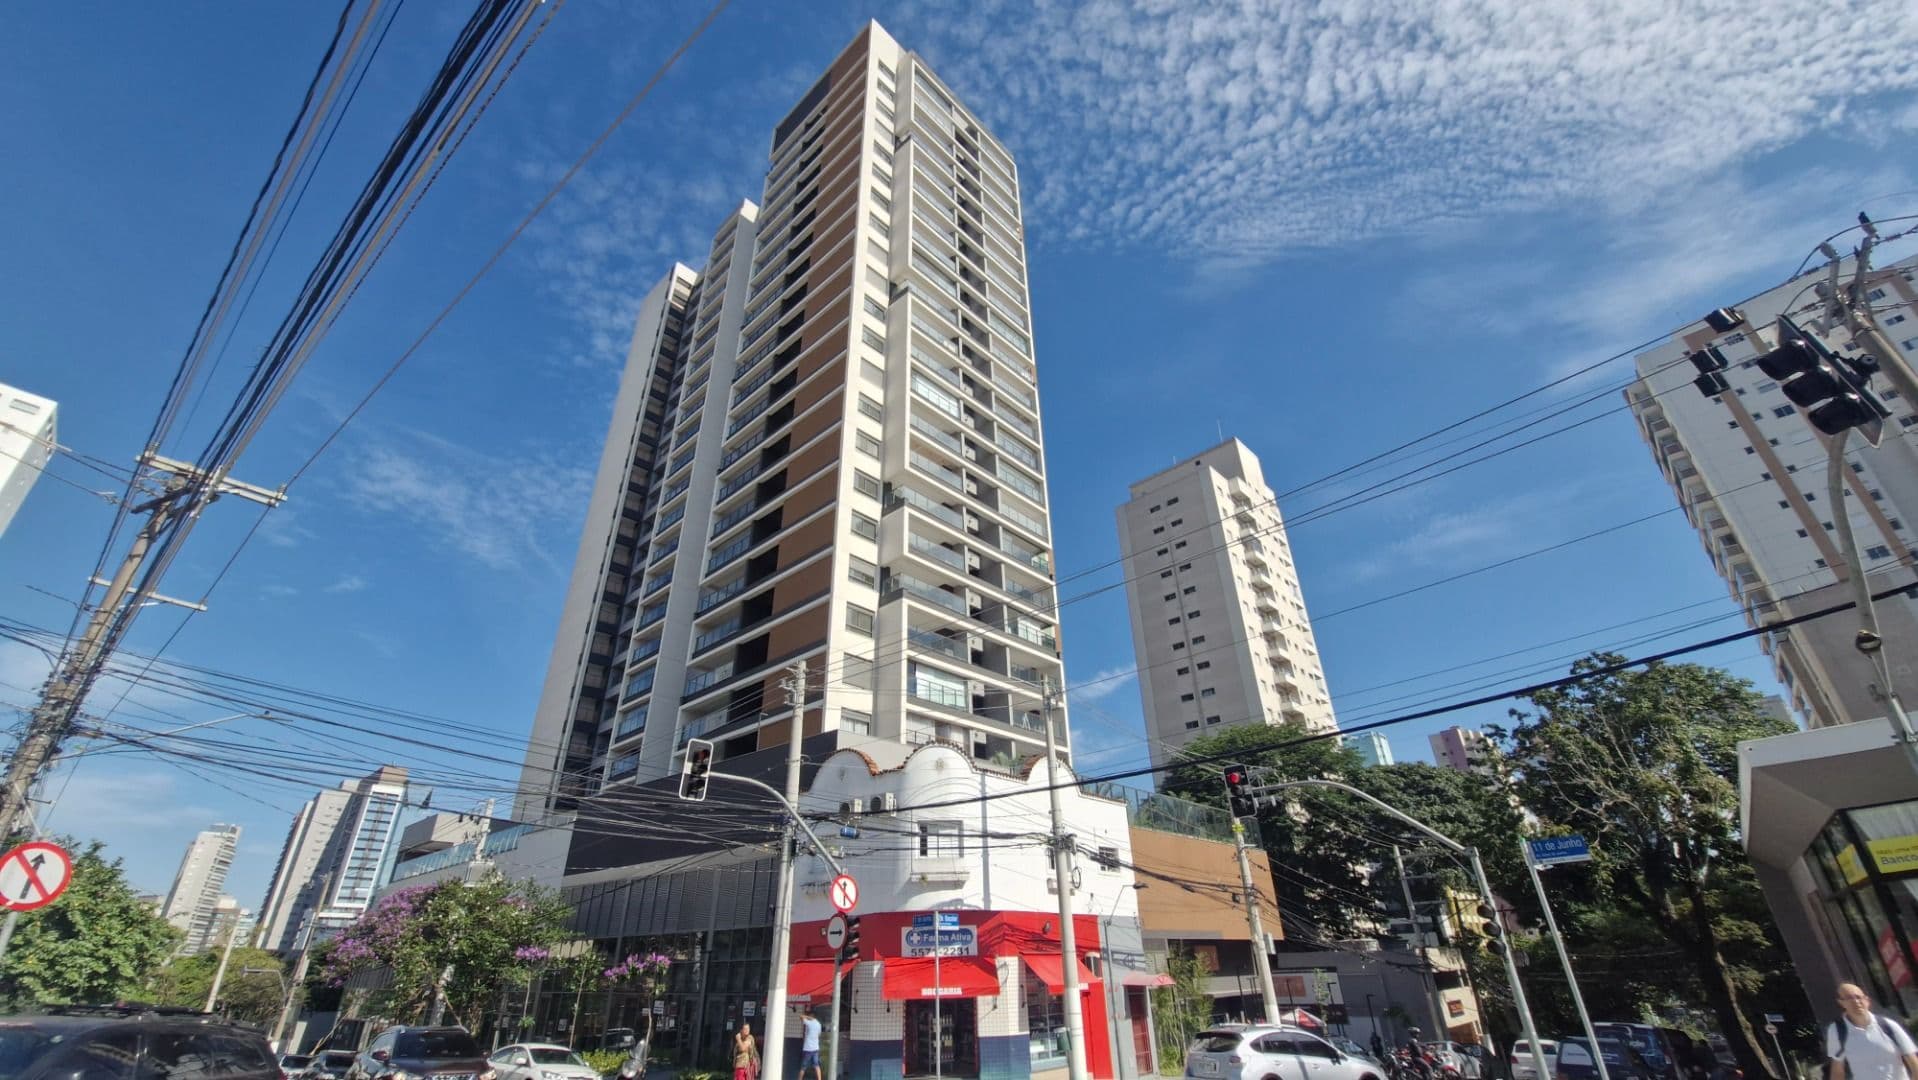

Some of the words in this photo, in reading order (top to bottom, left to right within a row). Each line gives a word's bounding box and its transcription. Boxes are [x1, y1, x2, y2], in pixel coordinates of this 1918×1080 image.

[1544, 841, 1556, 851] de
[1557, 839, 1582, 849] Junho
[951, 933, 972, 942] Ativa
